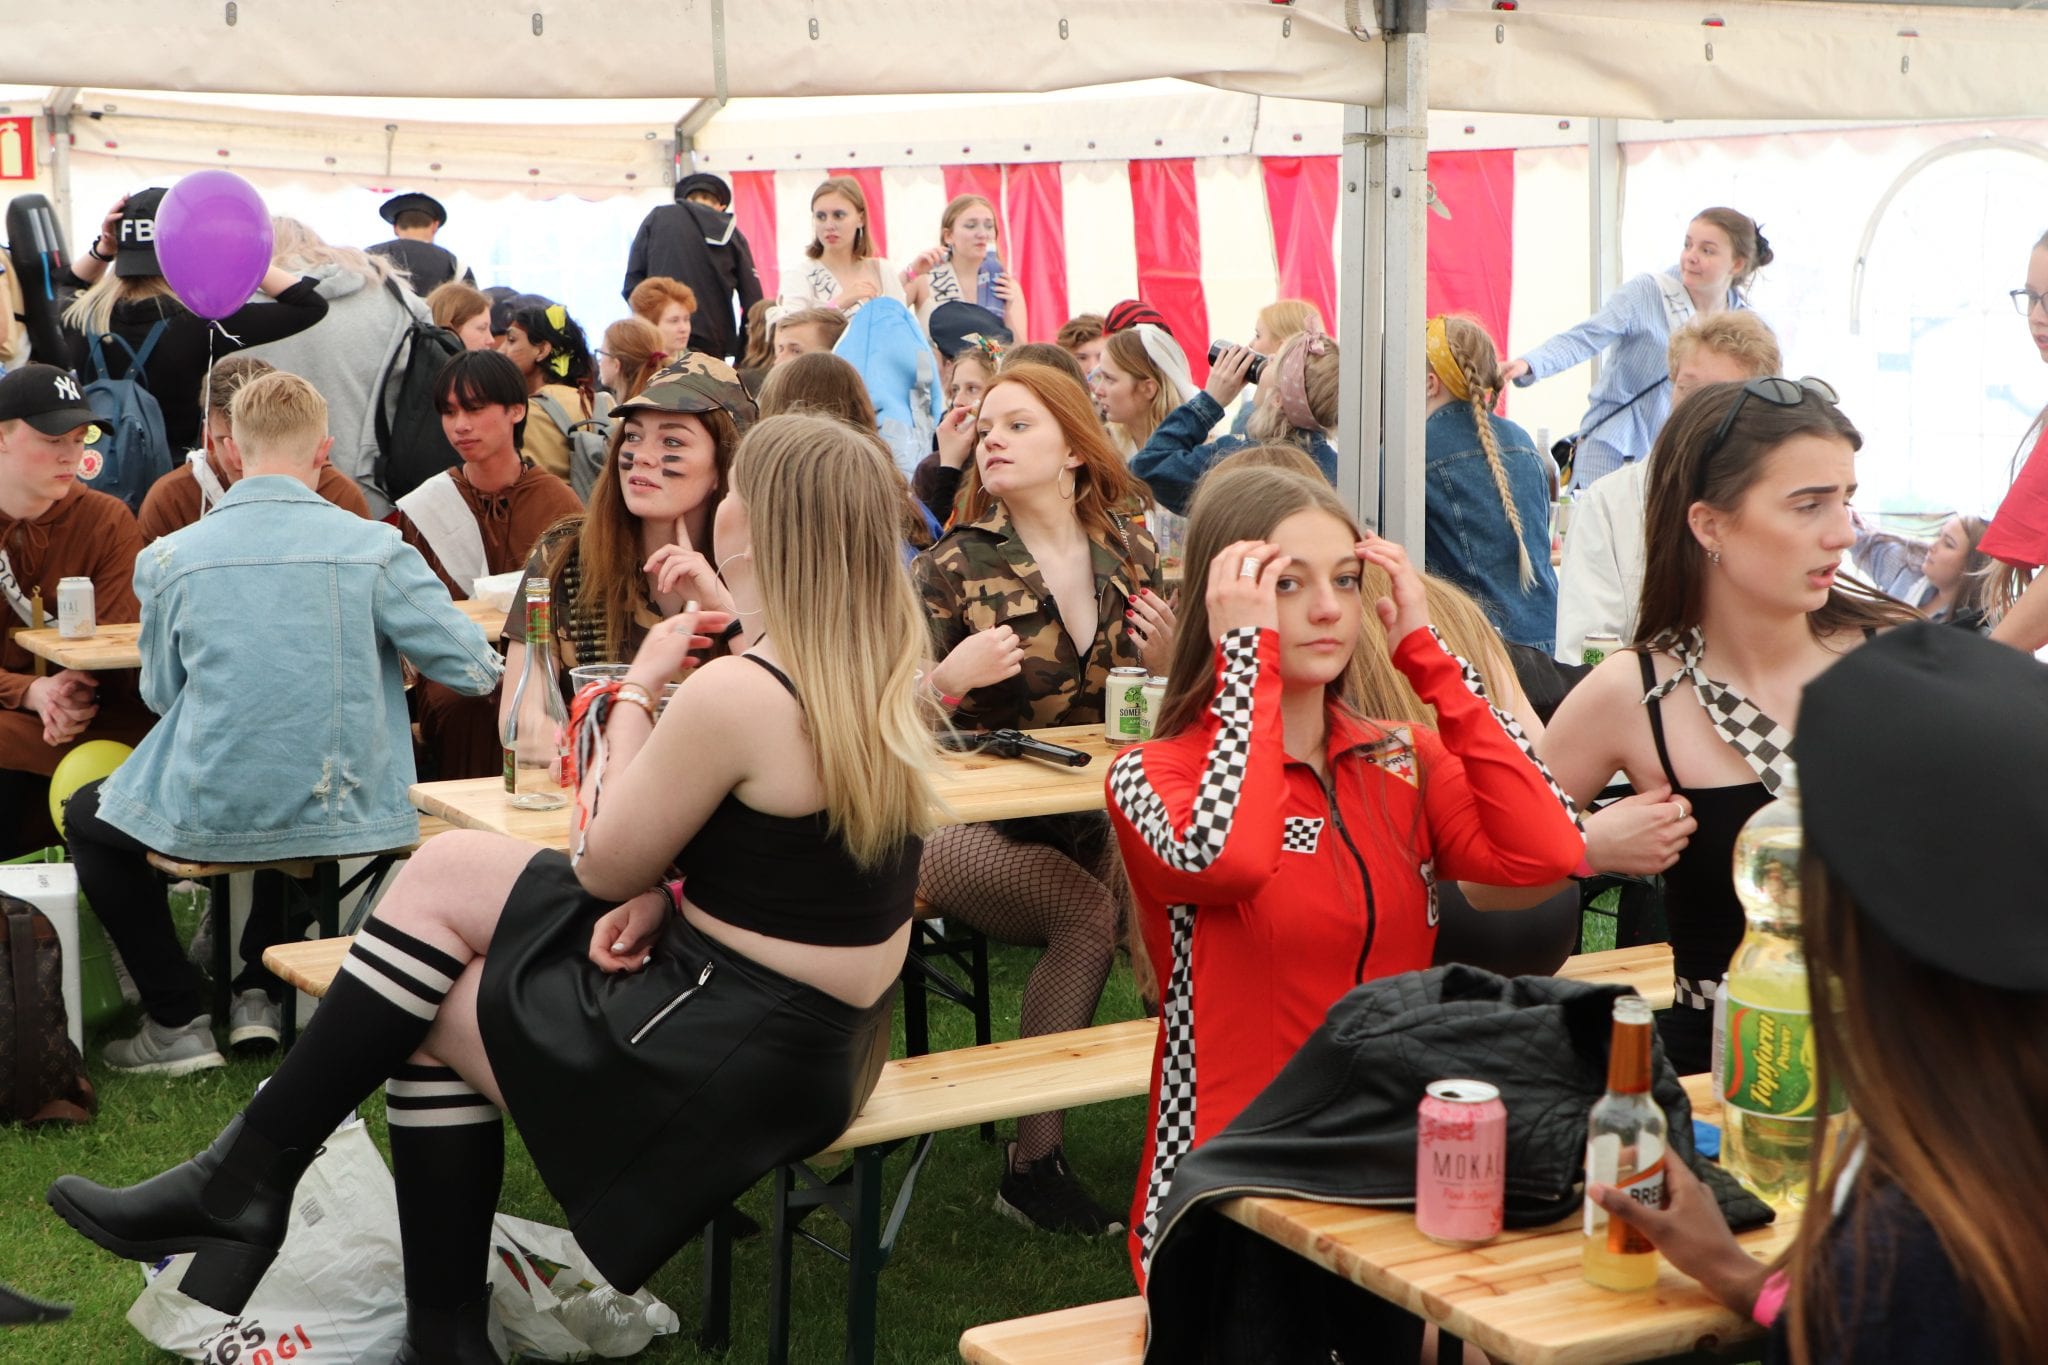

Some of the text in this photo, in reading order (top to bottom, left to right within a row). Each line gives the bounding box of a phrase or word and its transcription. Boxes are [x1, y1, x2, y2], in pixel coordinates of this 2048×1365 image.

[120, 218, 155, 242] FB
[53, 375, 81, 400] NY
[238, 1323, 313, 1365] OGI
